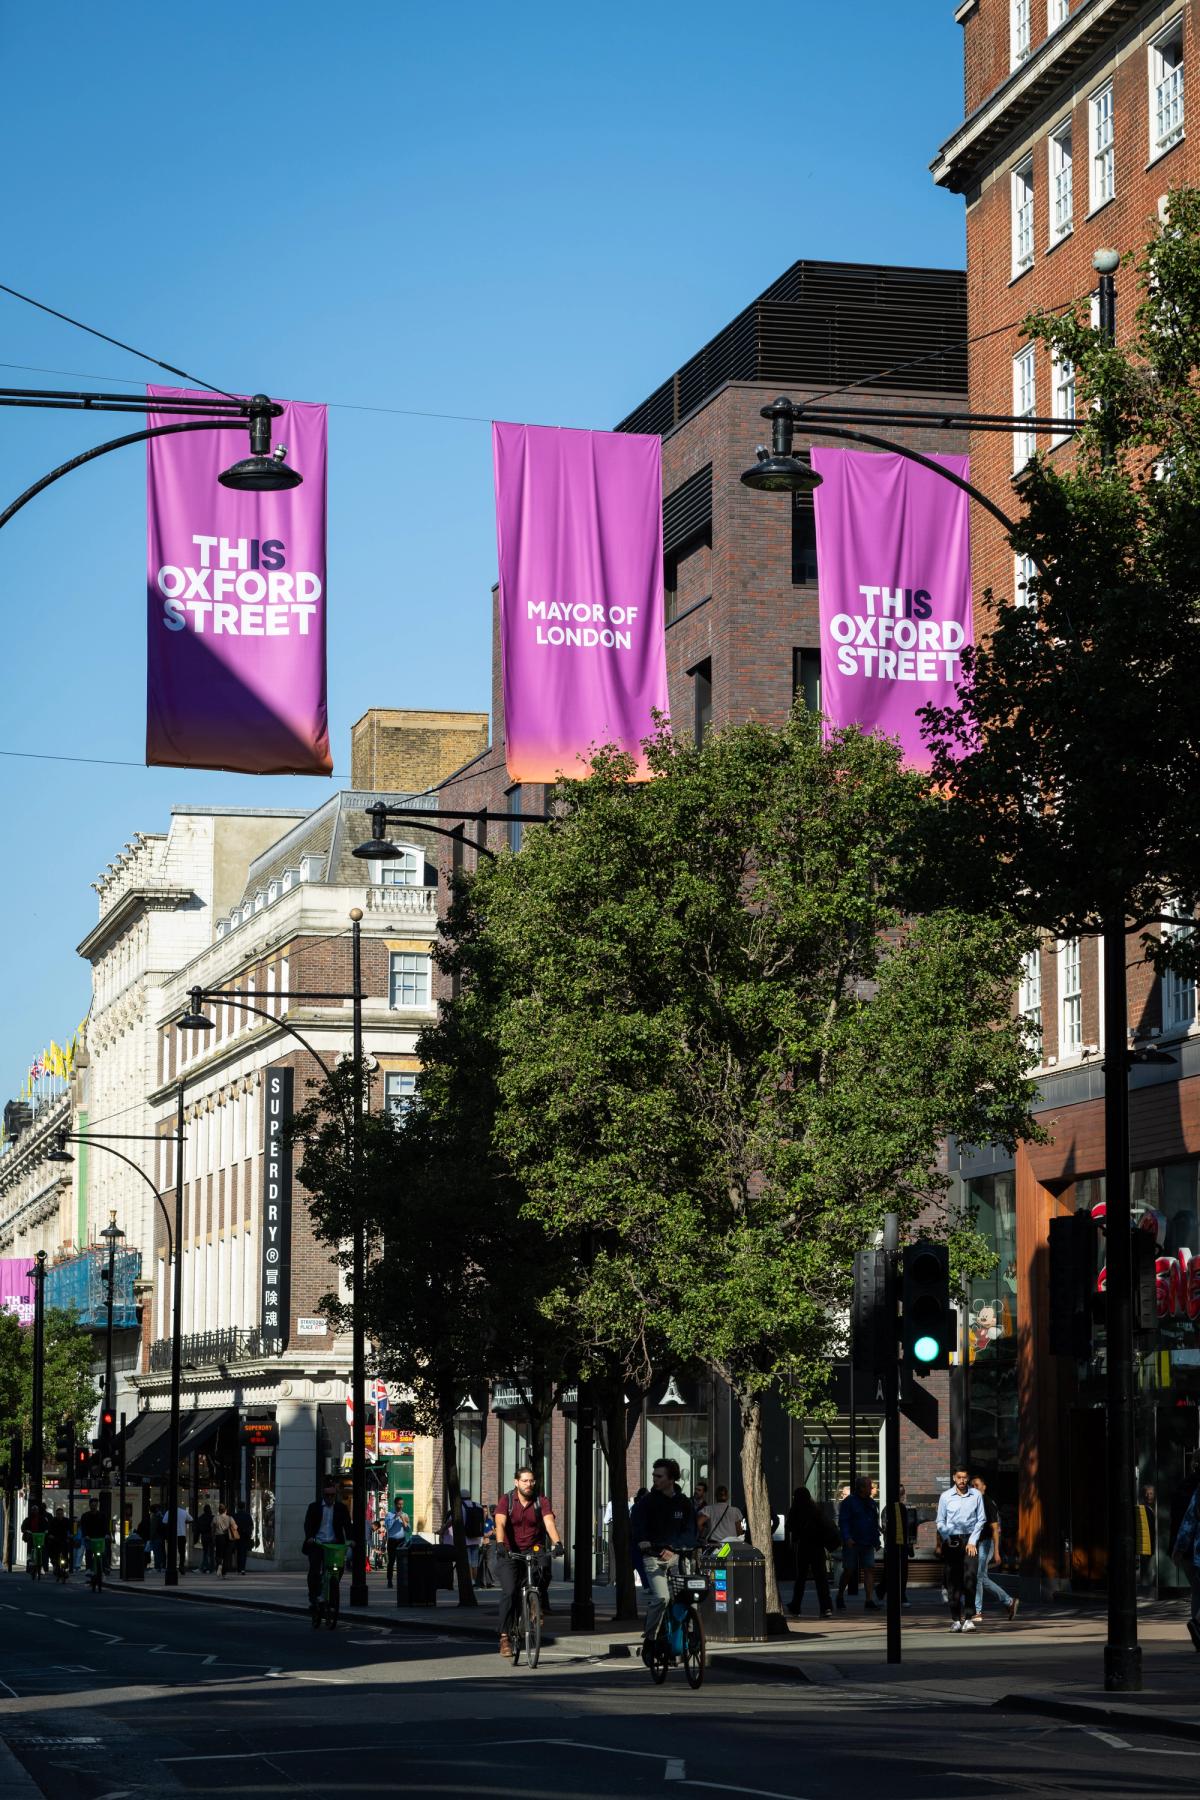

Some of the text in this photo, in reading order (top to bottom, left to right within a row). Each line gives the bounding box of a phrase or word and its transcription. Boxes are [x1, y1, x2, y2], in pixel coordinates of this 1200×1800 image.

[192, 534, 286, 571] THIS
[157, 565, 322, 603] OXFORD
[859, 585, 933, 619] THIS
[163, 598, 317, 636] STREET
[527, 600, 638, 625] MAYOR OF
[536, 625, 631, 649] LONDON
[829, 613, 965, 650] OXFORD
[837, 644, 960, 682] STREET
[5, 1295, 30, 1304] THIS
